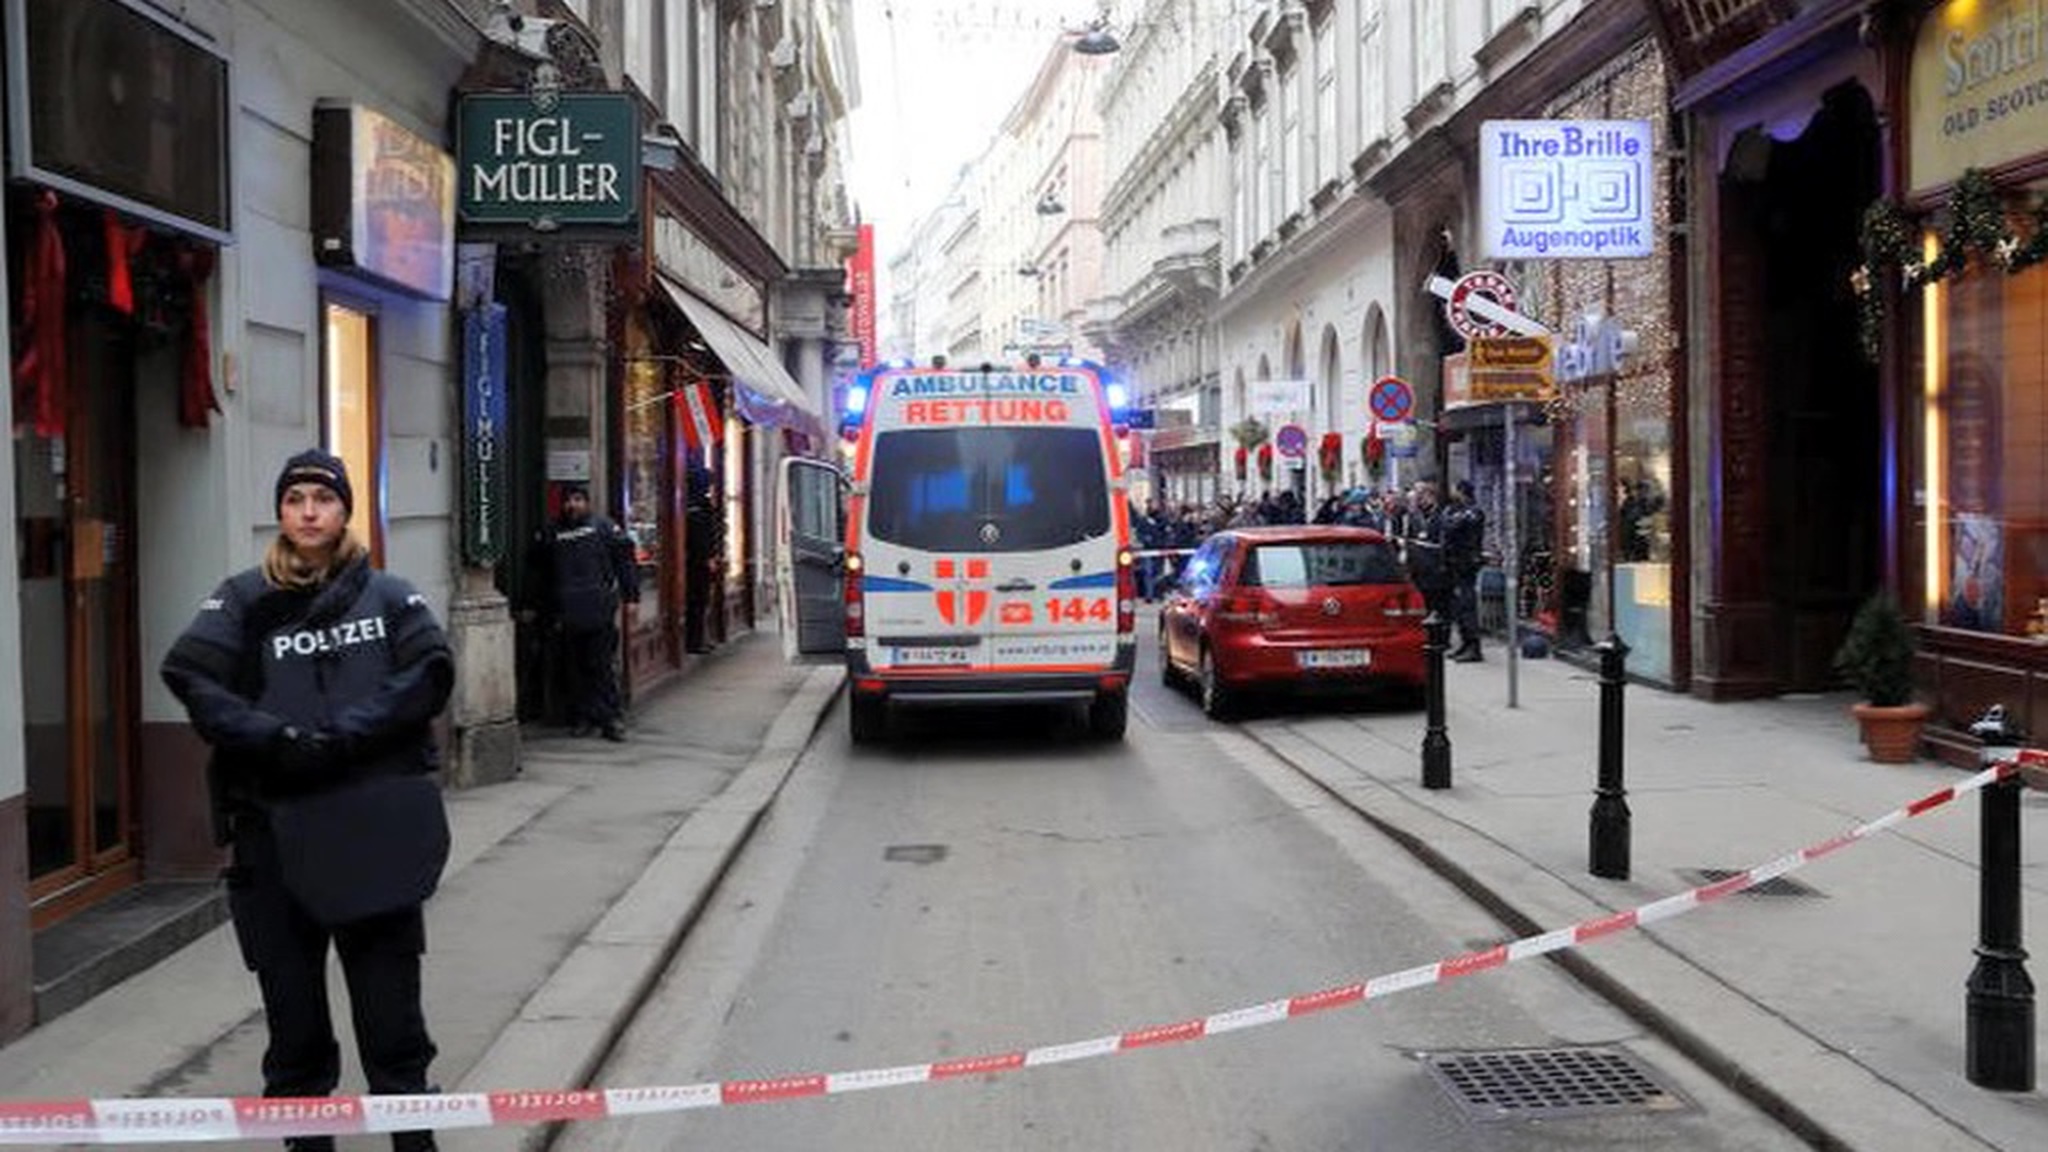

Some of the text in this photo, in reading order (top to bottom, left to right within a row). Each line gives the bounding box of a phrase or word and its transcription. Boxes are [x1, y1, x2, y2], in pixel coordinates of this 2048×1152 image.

[1943, 107, 1979, 136] OLD
[494, 118, 603, 156] FIGL-
[472, 161, 620, 203] MÜLLER
[1502, 226, 1641, 252] Augenoptik
[892, 375, 1078, 396] AMBULANCE
[904, 400, 1069, 424] RETTUNG
[1046, 597, 1112, 623] 144
[273, 617, 387, 660] POLIZEI
